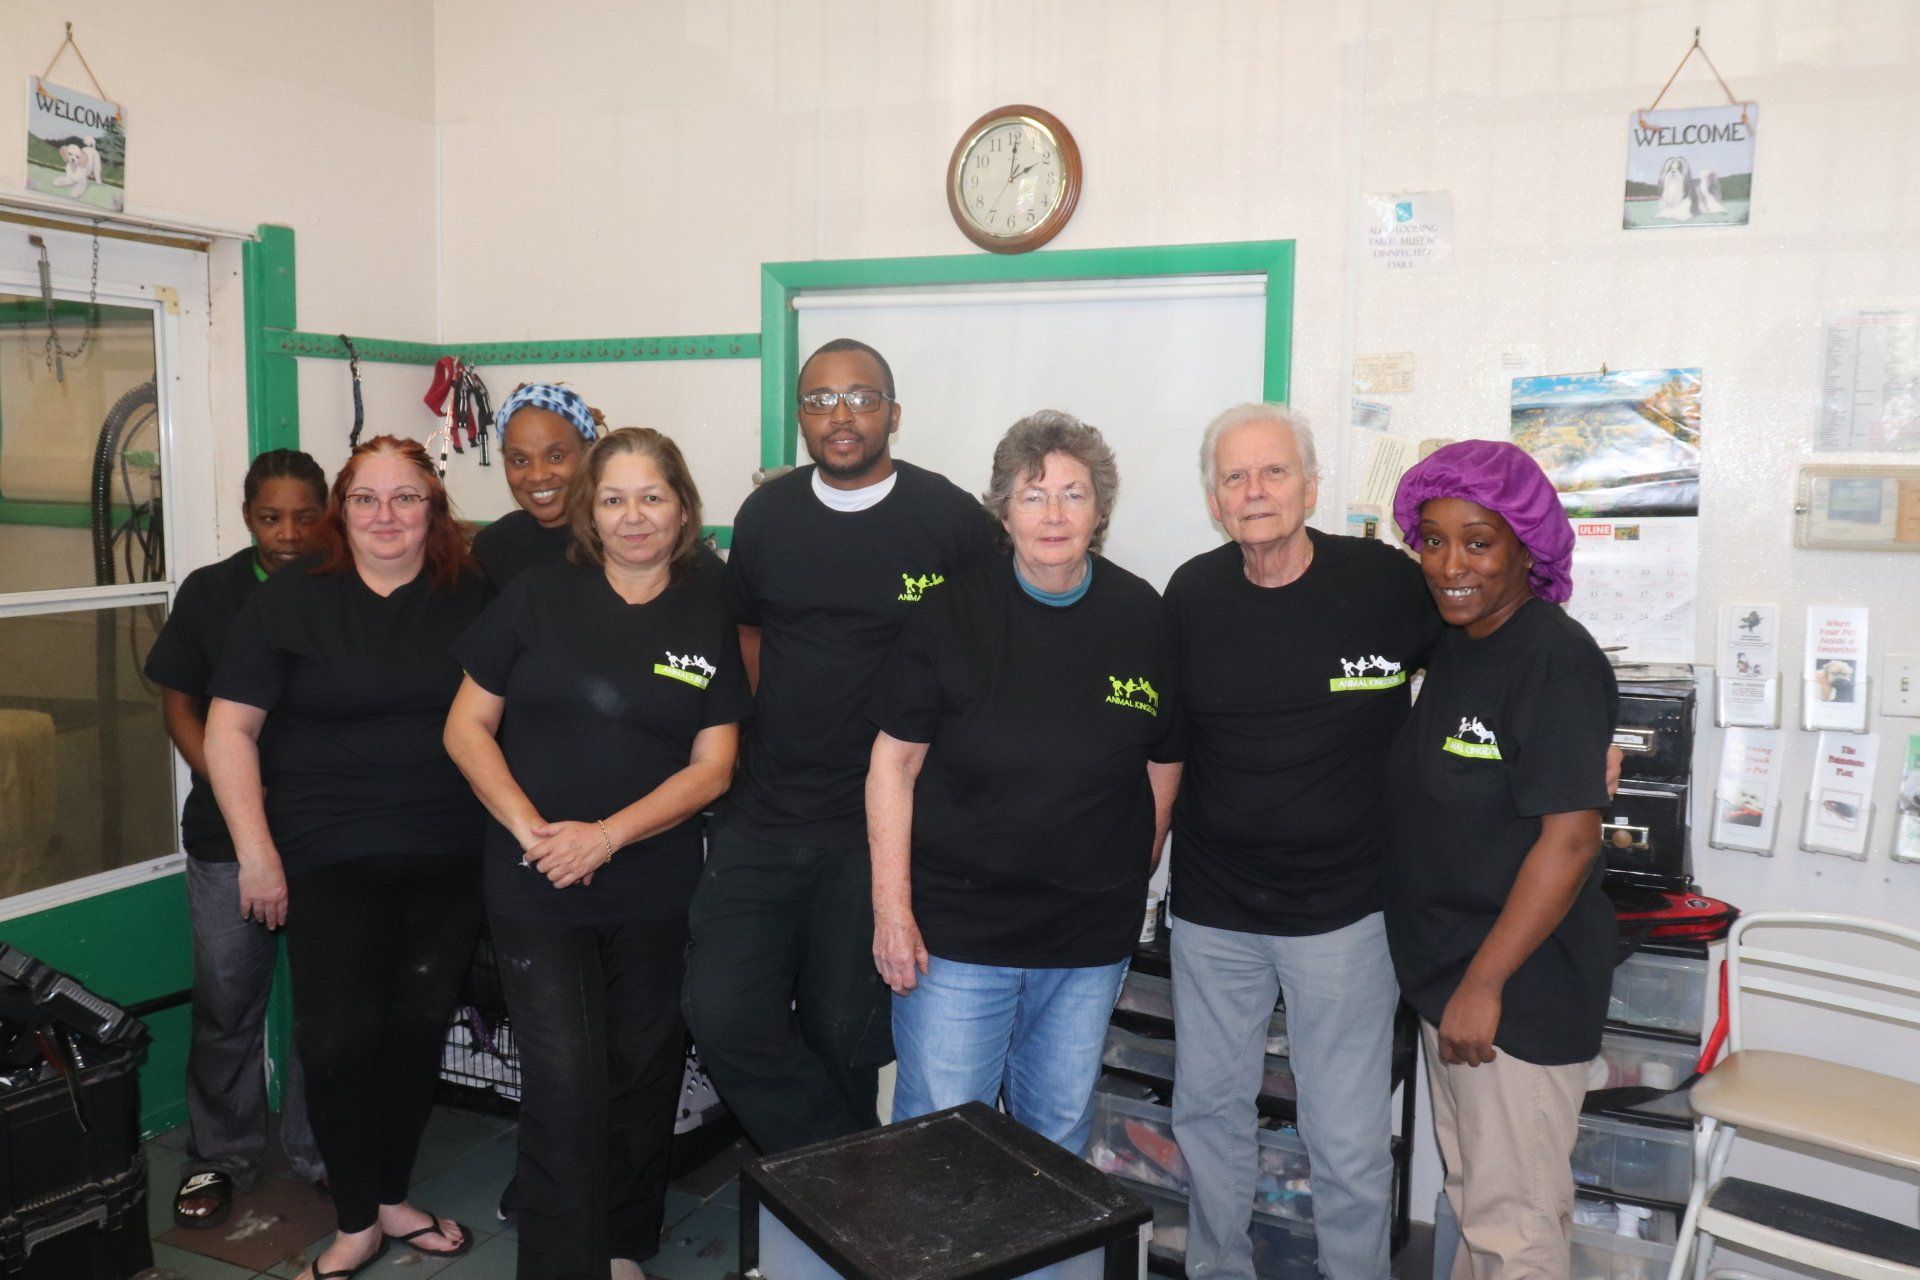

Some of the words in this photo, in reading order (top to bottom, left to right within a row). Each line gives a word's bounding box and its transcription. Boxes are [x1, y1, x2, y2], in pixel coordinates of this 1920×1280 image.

[36, 92, 120, 135] WELCOME
[1007, 131, 1022, 146] 12
[1634, 122, 1745, 146] WELCOME
[989, 138, 1002, 152] 11
[1031, 137, 1036, 150] 1
[976, 155, 990, 168] 10
[1042, 152, 1051, 165] 2
[970, 175, 979, 189] 9
[1047, 172, 1055, 186] 3
[975, 195, 984, 209] 8
[1041, 194, 1050, 207] 4
[989, 210, 997, 224] 7
[1006, 215, 1016, 228] 6
[1026, 209, 1035, 222] 5
[1580, 525, 1611, 535] ULINE
[1105, 695, 1134, 707] ANIMAL
[187, 1172, 216, 1187] NIKE
